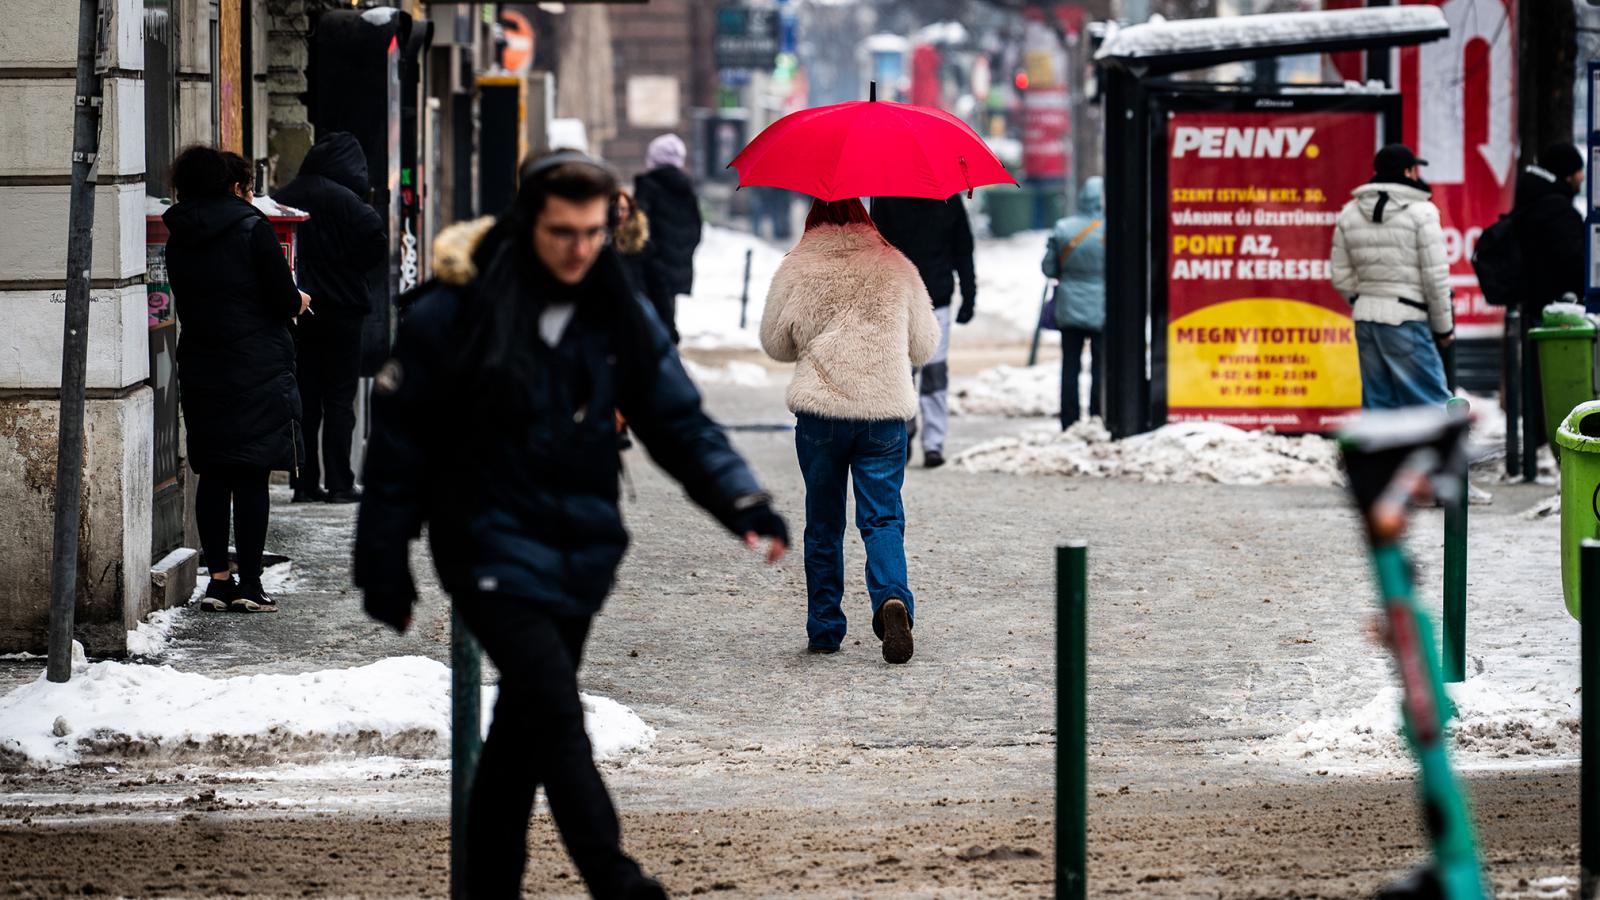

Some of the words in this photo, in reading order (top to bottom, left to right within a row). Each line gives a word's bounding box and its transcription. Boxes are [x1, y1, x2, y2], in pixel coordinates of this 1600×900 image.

[1172, 127, 1320, 159] PENNY.
[1172, 188, 1214, 202] SZENT
[1216, 185, 1267, 202] ISTVÁN
[1269, 188, 1301, 202] KRT.
[1172, 208, 1232, 225] VÁRUNK
[1235, 208, 1251, 225] ÚJ
[1173, 235, 1236, 254] PONT
[1240, 235, 1279, 258] AZ,
[1172, 259, 1233, 280] AMIT
[1177, 328, 1352, 344] MEGNYITOTTUNK
